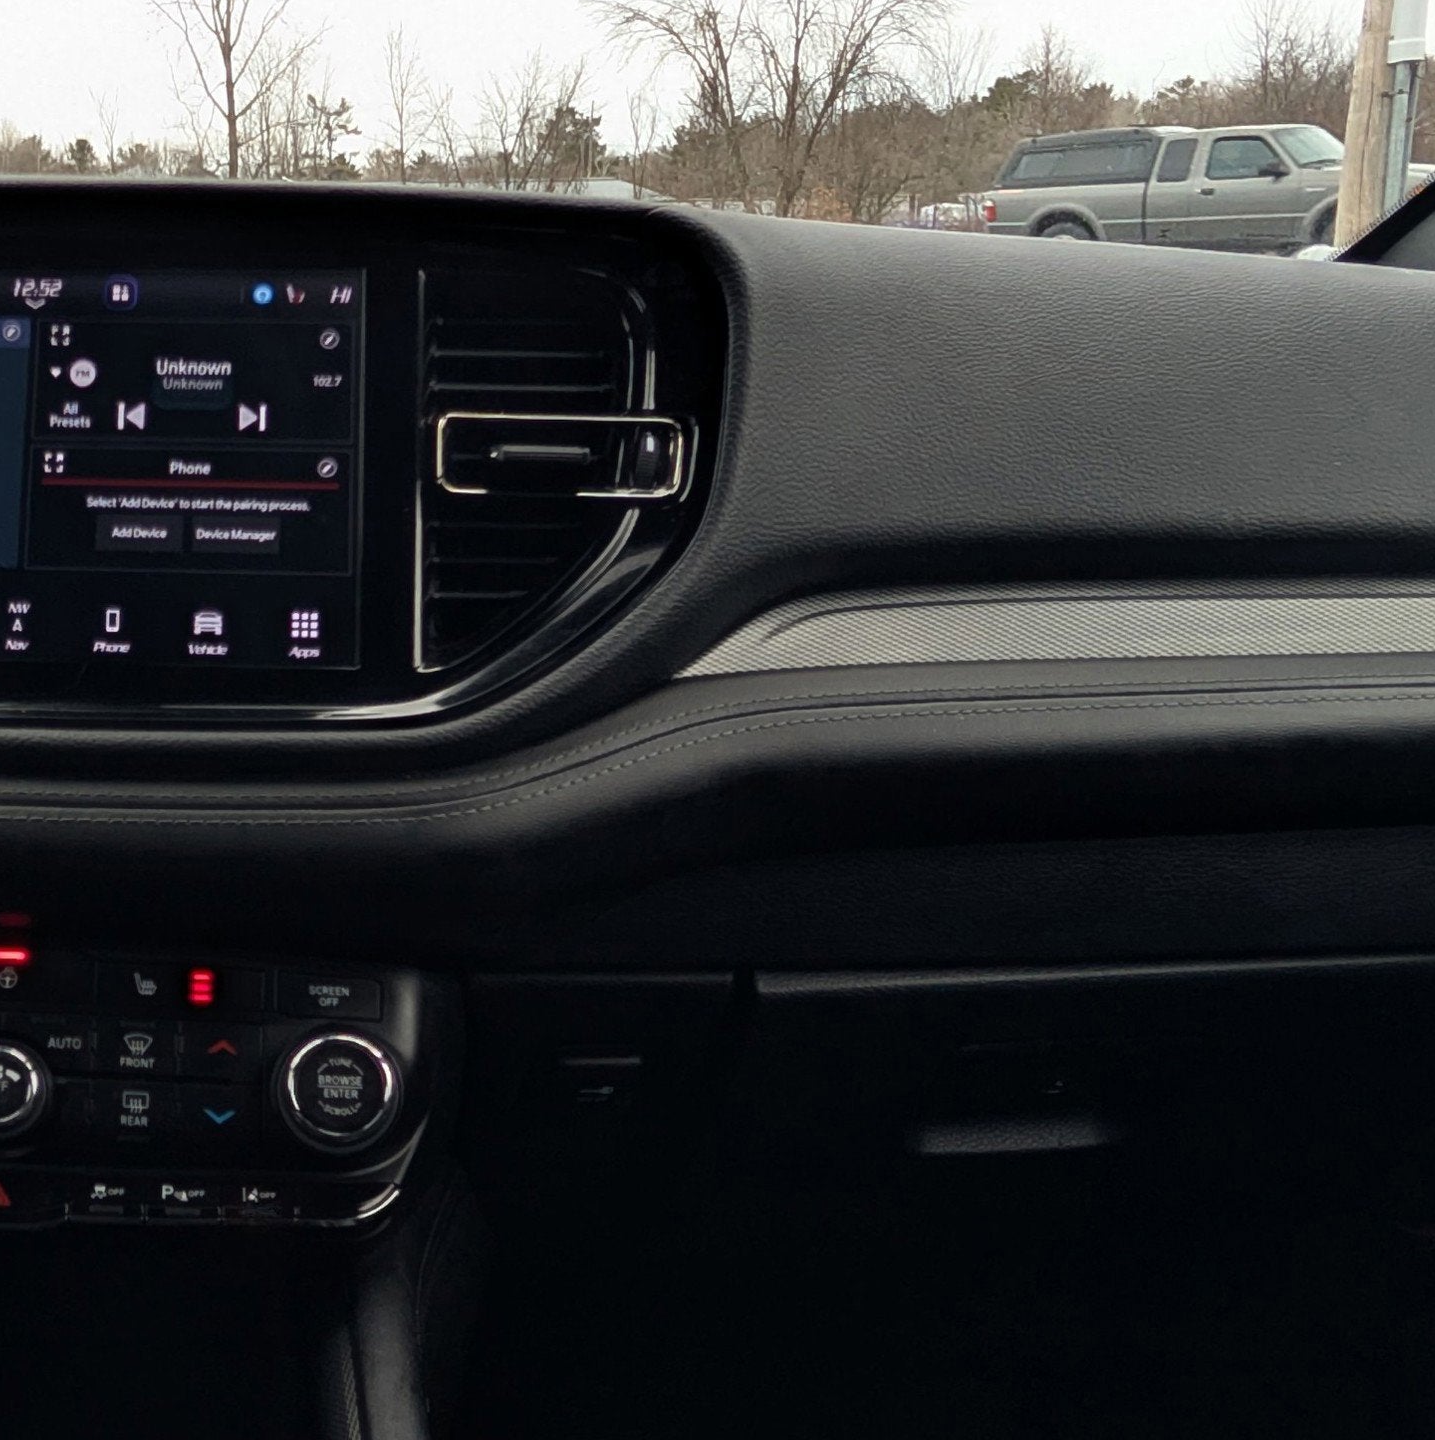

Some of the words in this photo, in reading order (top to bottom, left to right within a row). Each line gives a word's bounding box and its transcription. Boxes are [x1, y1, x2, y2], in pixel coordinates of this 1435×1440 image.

[13, 278, 63, 298] 12:52
[330, 285, 353, 304] HI
[156, 360, 231, 377] Unknown
[162, 377, 223, 391] Unknown
[63, 402, 78, 416] All
[49, 415, 91, 430] Presets
[169, 459, 211, 476] Phone
[86, 496, 116, 509] Select
[179, 499, 190, 510] to
[192, 499, 214, 511] start
[216, 498, 231, 511] the
[233, 499, 267, 514] pairing
[111, 526, 132, 539] Add
[133, 527, 167, 539] Device
[196, 527, 229, 540] Device
[231, 528, 277, 543] Manager
[5, 640, 29, 651] Nav
[92, 641, 131, 654] Phone
[188, 643, 228, 656] Vehicle
[289, 646, 320, 660] Apps
[308, 984, 350, 997] SCREEN
[319, 997, 339, 1008] OFF
[47, 1036, 82, 1050] AUTO
[120, 1056, 156, 1069] FRONT
[317, 1074, 363, 1087] BROWSE
[323, 1088, 359, 1101] ENTER
[120, 1114, 148, 1128] REAR
[188, 1189, 205, 1198] OFF
